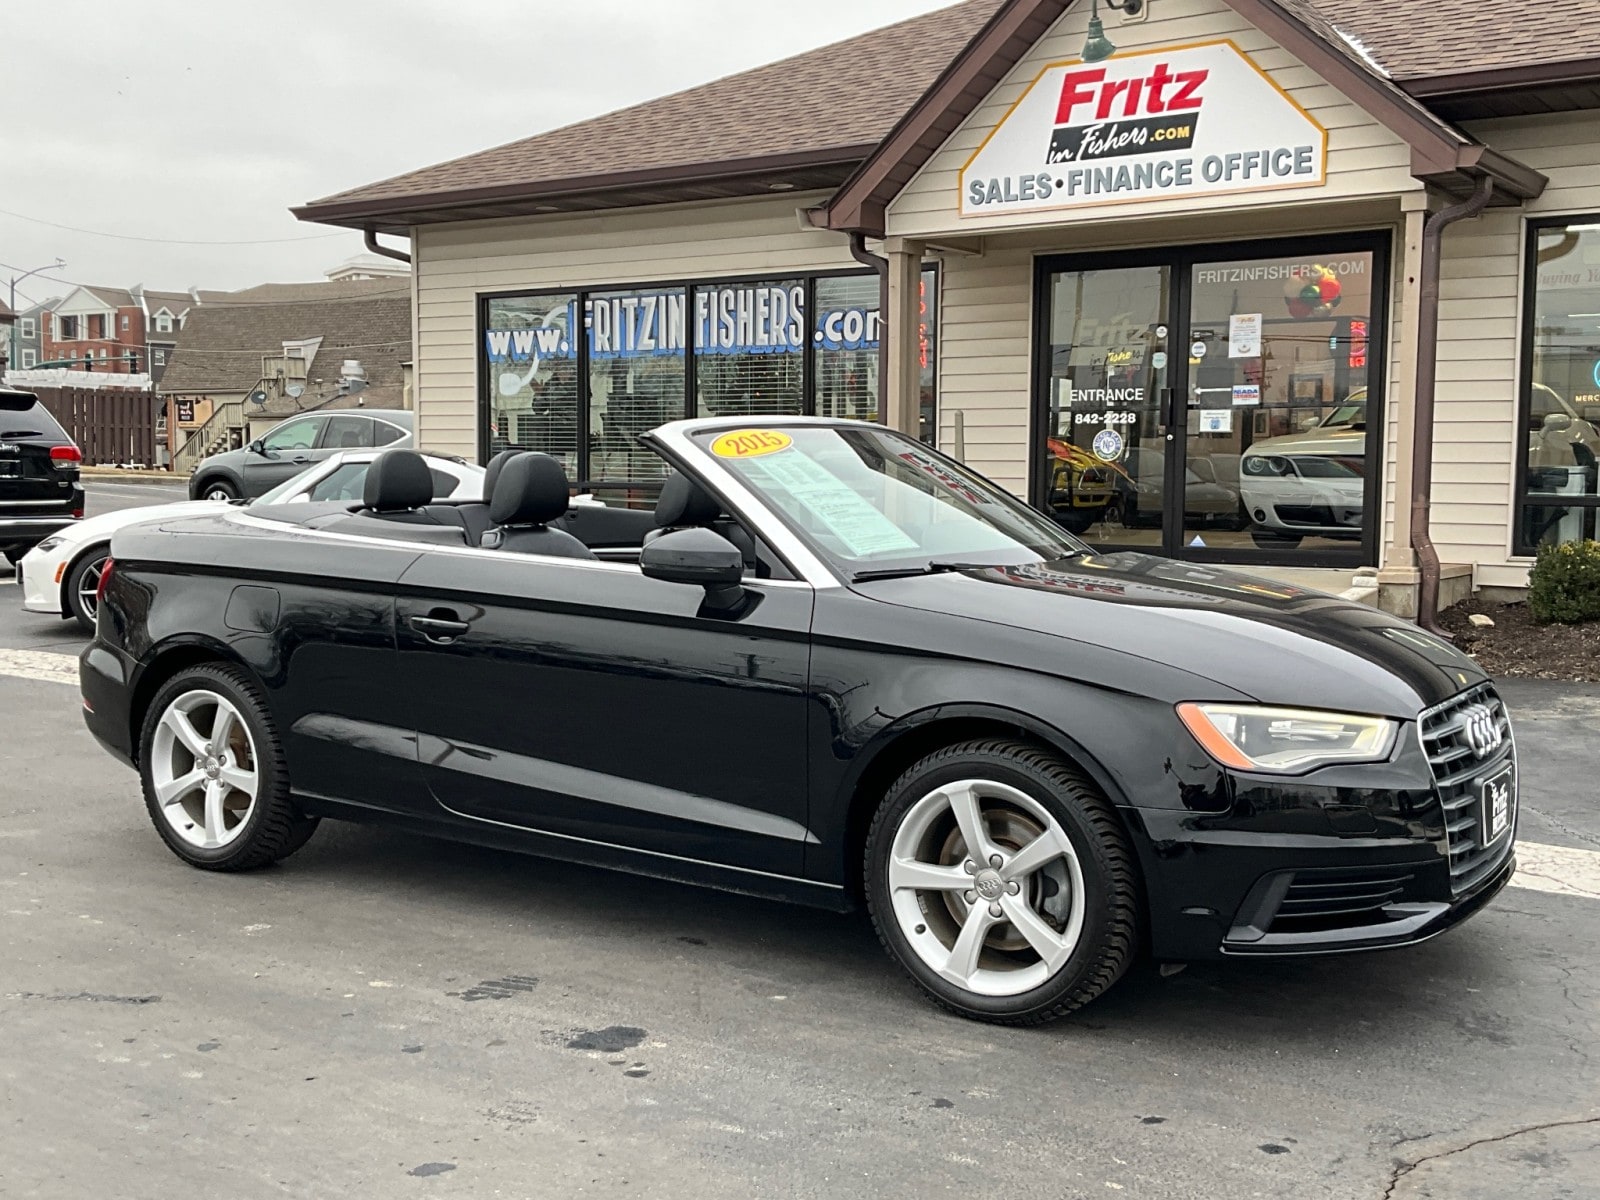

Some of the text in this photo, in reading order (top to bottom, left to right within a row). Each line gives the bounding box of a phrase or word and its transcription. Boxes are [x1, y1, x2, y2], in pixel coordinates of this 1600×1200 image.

[1054, 63, 1209, 125] Fritz
[1048, 141, 1073, 164] in
[969, 146, 1313, 206] SALES FINANCE OFFICE
[1198, 260, 1364, 284] FRITZINFISHERSCOM
[1070, 388, 1144, 401] ENTRANCE
[1074, 412, 1137, 424] 842-2228
[725, 431, 783, 455] 2015
